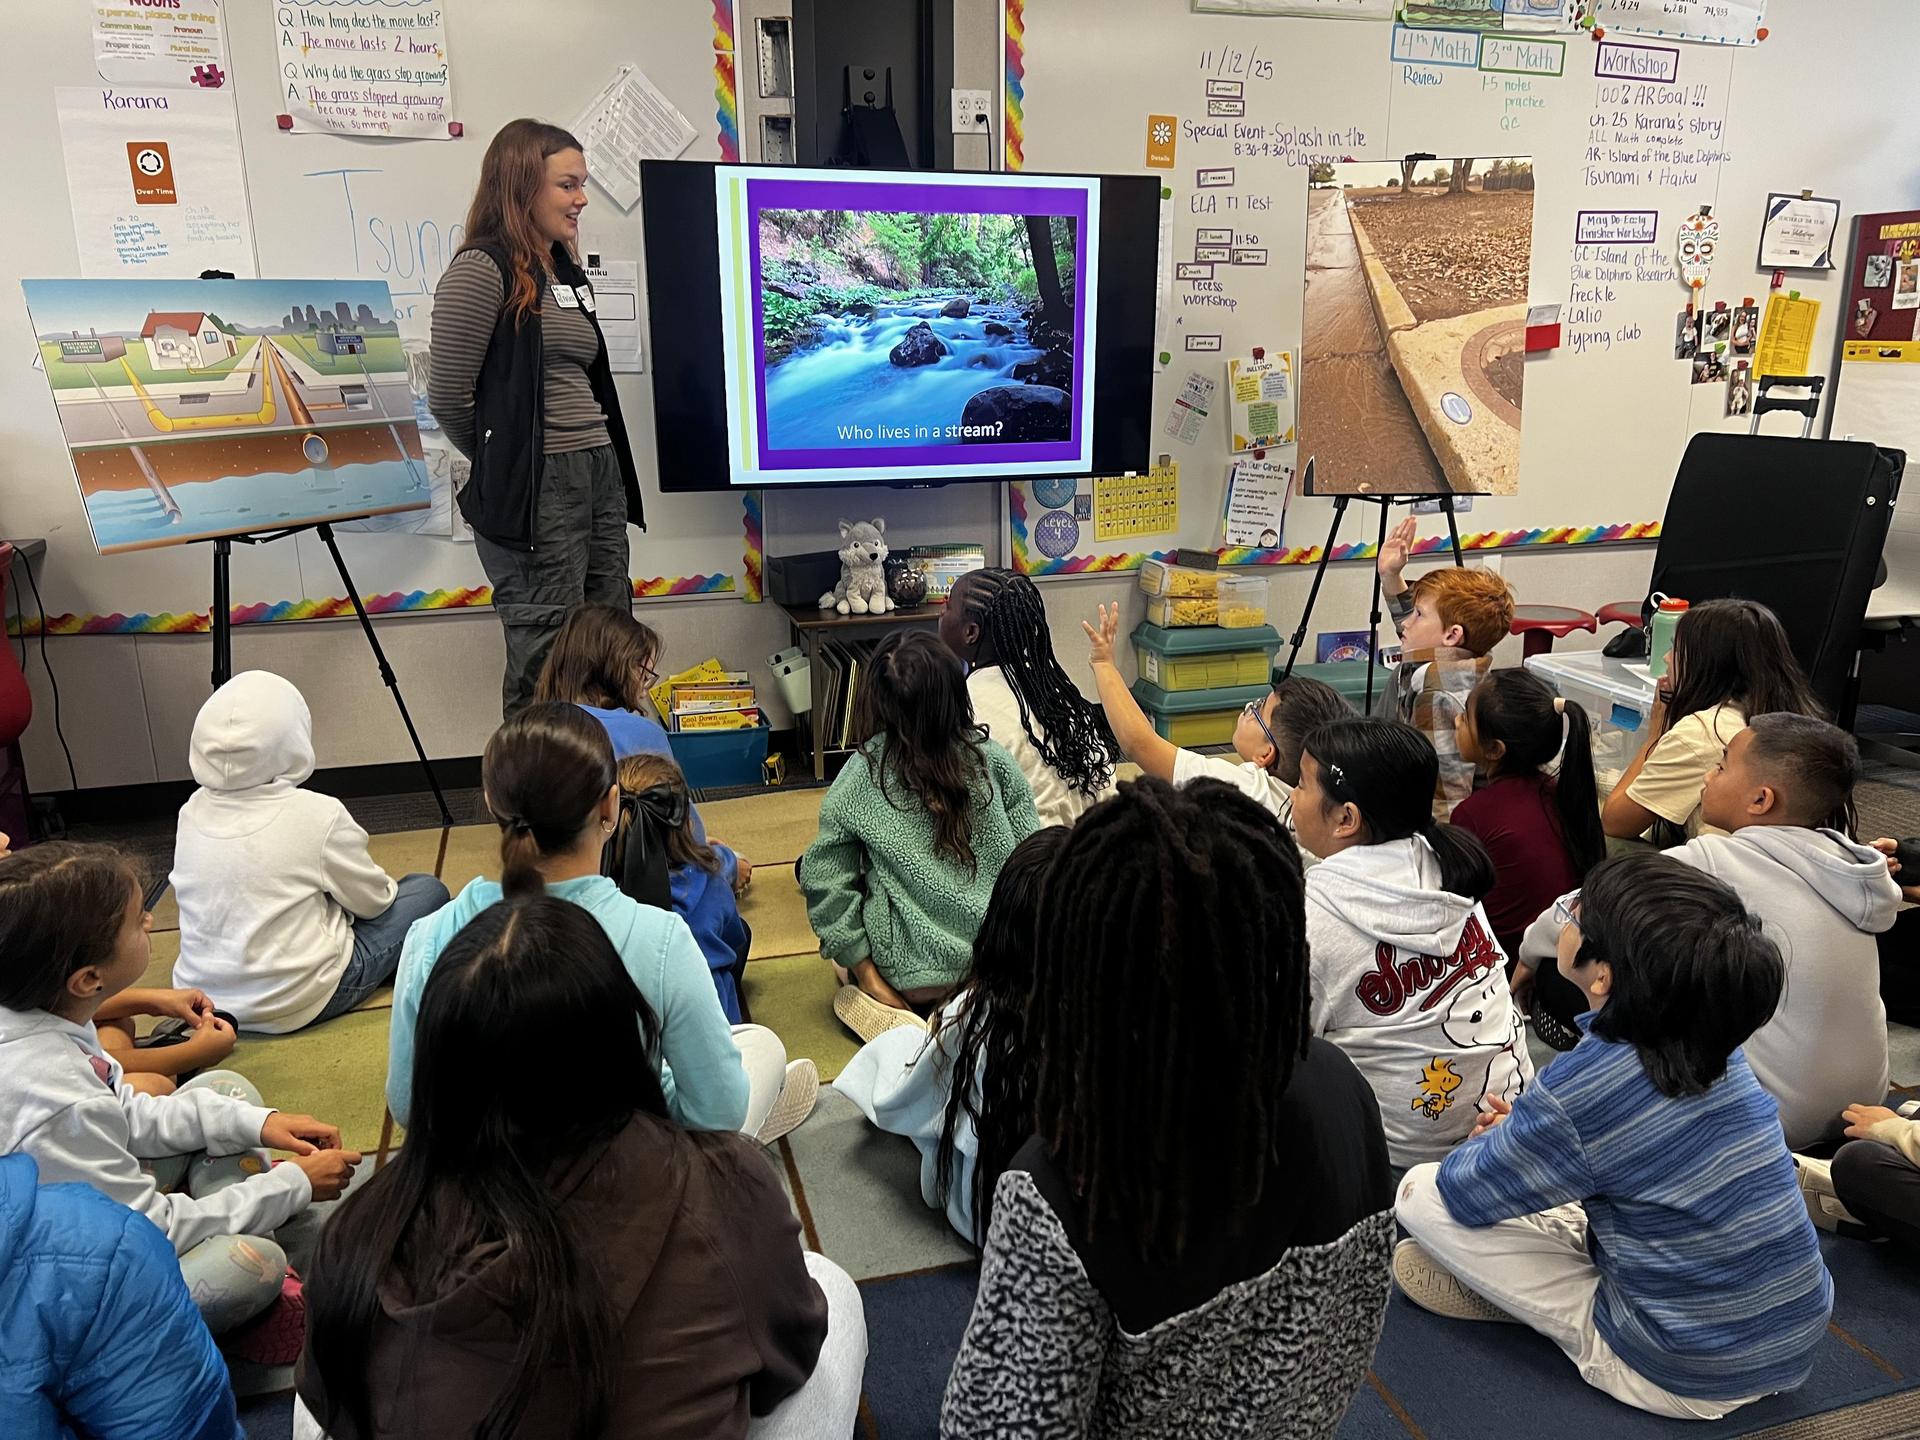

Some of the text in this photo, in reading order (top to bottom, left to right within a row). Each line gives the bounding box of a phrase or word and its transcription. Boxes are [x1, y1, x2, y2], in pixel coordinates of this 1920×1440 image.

[100, 21, 132, 30] Common
[191, 12, 216, 24] thing
[300, 9, 325, 28] How
[328, 11, 350, 33] long
[352, 10, 371, 29] does
[372, 12, 386, 28] the
[389, 13, 415, 28] movie
[417, 10, 441, 28] last?
[173, 25, 203, 34] Pronoun
[105, 41, 151, 50] Proper Noun
[300, 31, 321, 48] The
[324, 36, 356, 49] movie
[360, 35, 387, 51] lasts
[394, 35, 405, 53] 2
[1401, 32, 1473, 62] 4th Math
[1486, 41, 1555, 71] 3rd Math
[1603, 47, 1669, 80] Workshop
[302, 63, 329, 82] Why
[332, 64, 347, 80] did
[350, 65, 364, 80] the
[366, 67, 391, 85] grass
[396, 66, 412, 83] stop
[1403, 64, 1443, 86] Review
[1504, 76, 1532, 92] notes
[102, 89, 169, 110] Karana
[307, 85, 328, 101] The
[331, 88, 360, 104] grass
[362, 88, 398, 107] stopped
[402, 94, 444, 110] growing
[1634, 84, 1654, 105] AR
[316, 102, 446, 123] because there was no rain
[1504, 96, 1546, 113] practice
[327, 120, 346, 129] this
[1612, 111, 1628, 128] 25
[1635, 112, 1684, 131] Karana's
[1182, 119, 1227, 143] Special
[1327, 130, 1342, 147] in
[1344, 126, 1366, 147] the
[1588, 129, 1684, 149] ALL Math complete
[1151, 153, 1170, 162] Details
[1233, 142, 1285, 157] 8:30-9:30
[1609, 149, 1639, 163] Island
[1642, 148, 1652, 162] of
[1654, 149, 1671, 162] the
[1672, 150, 1695, 164] Blue
[1696, 149, 1732, 166] Dolphins
[1581, 165, 1640, 186] Tsunami
[1659, 167, 1698, 186] Haiku
[156, 188, 174, 196] Time
[1191, 193, 1217, 214] ELA
[1246, 195, 1273, 211] Test
[1587, 215, 1608, 228] May
[1235, 234, 1259, 246] 11:50
[1580, 227, 1656, 242] Finisher Workshop
[1595, 246, 1628, 264] Island
[1634, 247, 1650, 267] of
[1650, 247, 1670, 265] the
[1570, 265, 1679, 282] Blue Dolphins Research
[1192, 280, 1224, 292] recess
[1569, 282, 1617, 303] Freckle
[1568, 306, 1602, 324] Lalio
[1567, 323, 1641, 354] typing club
[836, 420, 1004, 440] Who lives in a stream?
[1052, 478, 1060, 490] 3
[1054, 527, 1062, 539] 4
[681, 715, 697, 723] Cool
[698, 714, 718, 723] Down
